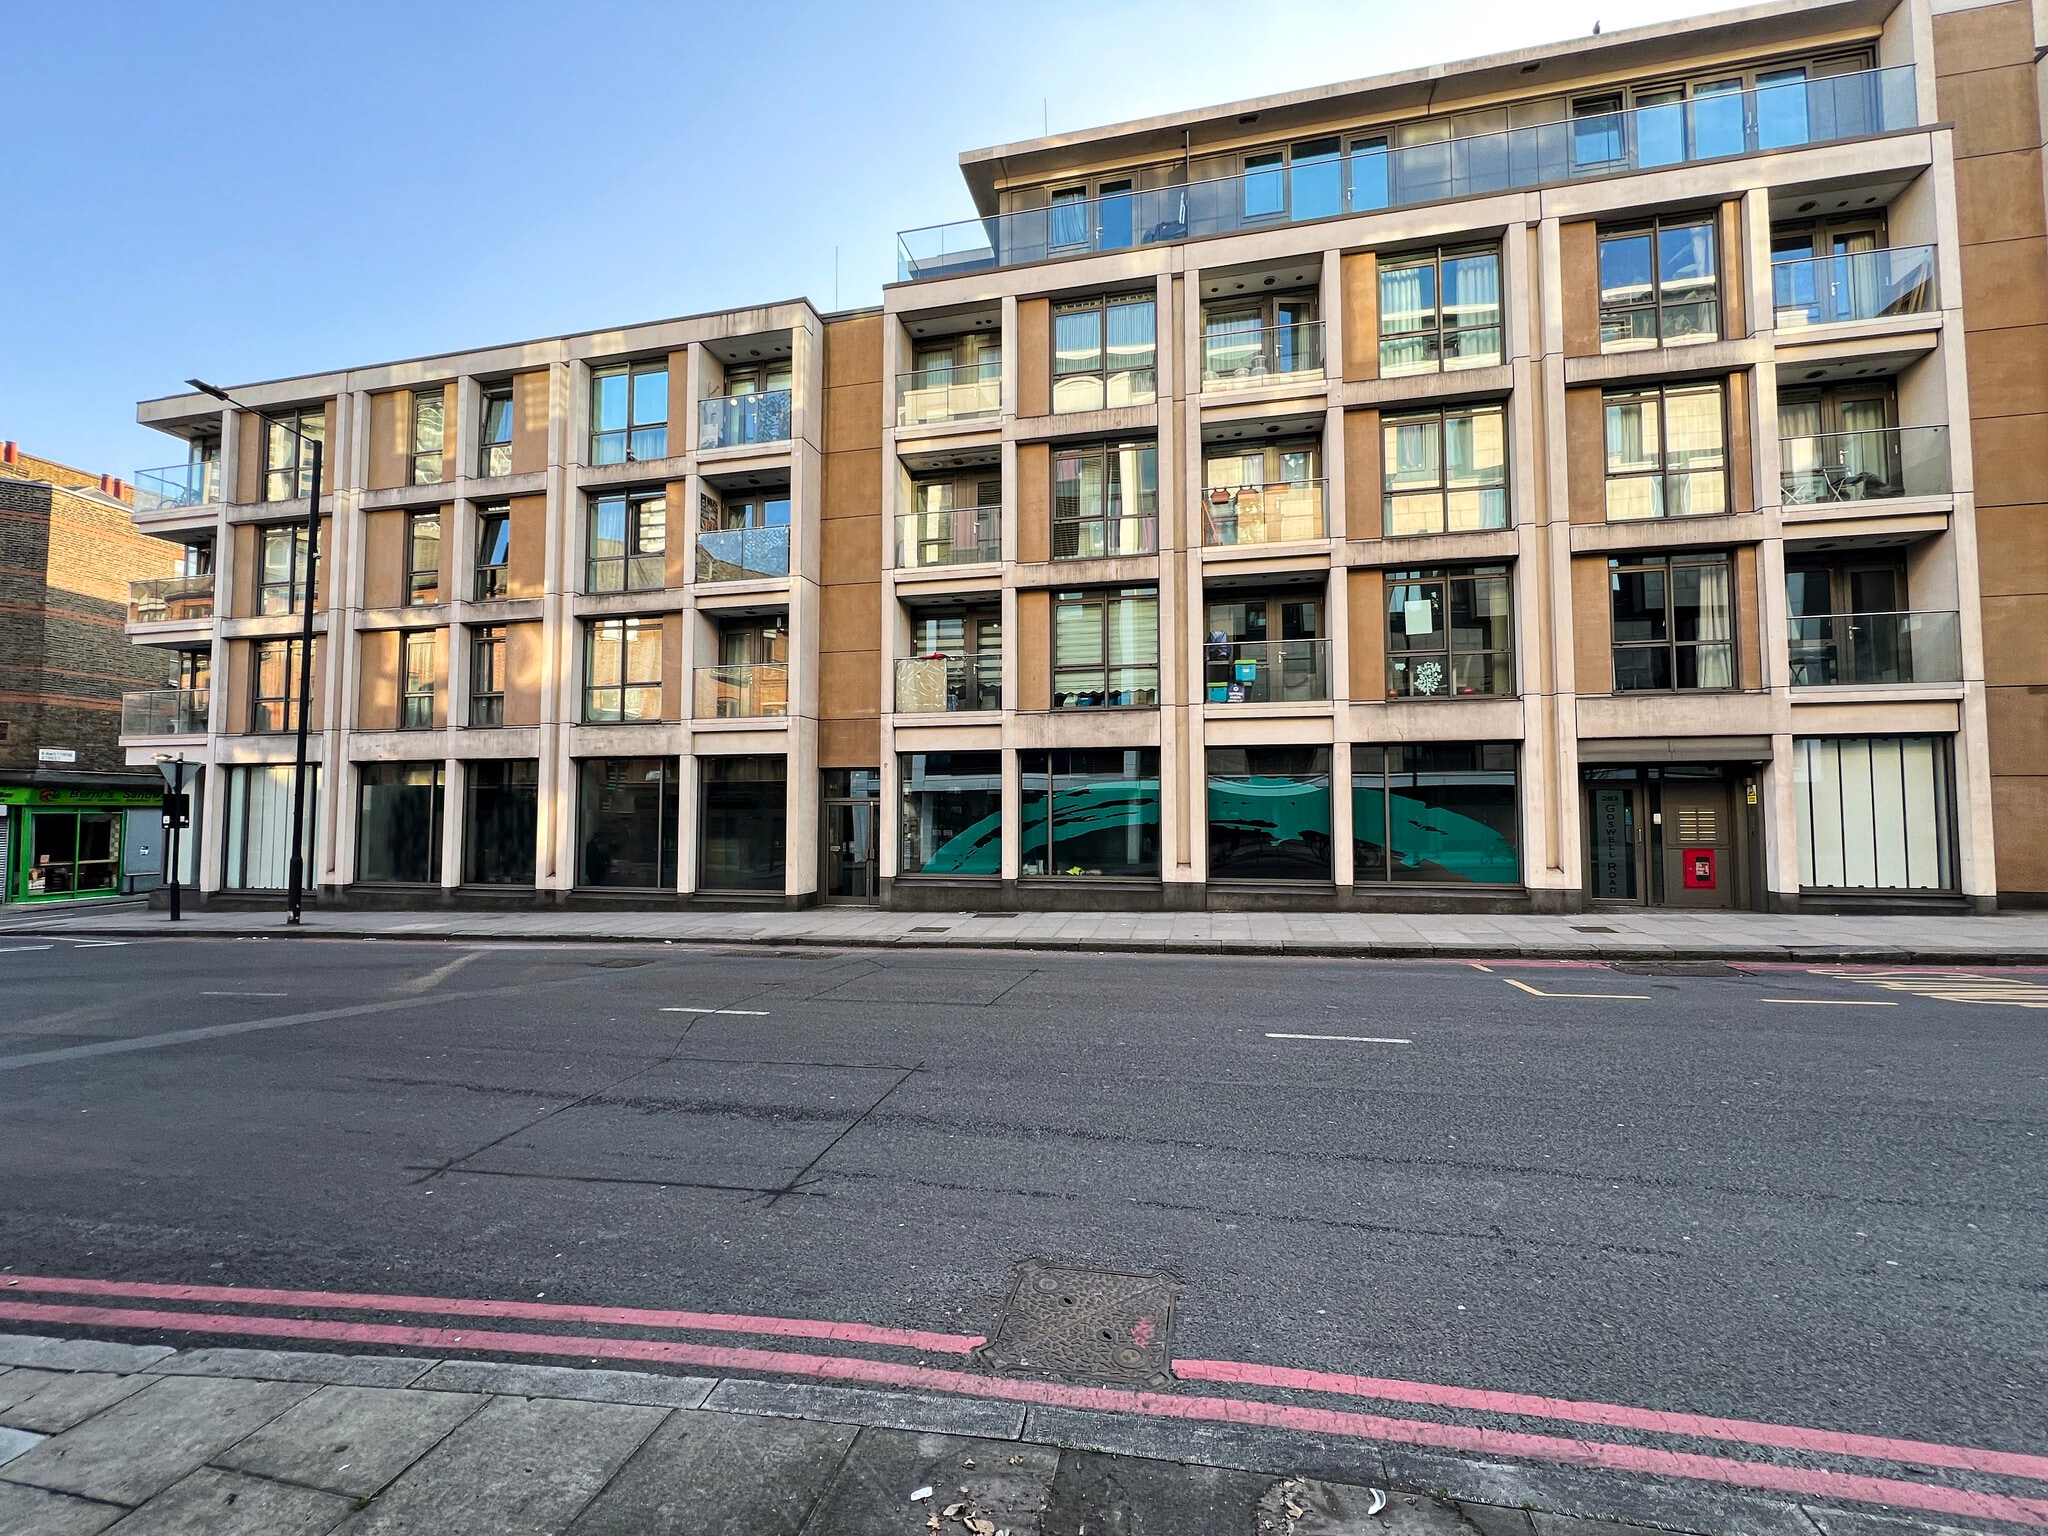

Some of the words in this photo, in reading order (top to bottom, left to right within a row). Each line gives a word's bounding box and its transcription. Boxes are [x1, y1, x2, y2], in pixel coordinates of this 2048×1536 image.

[122, 790, 163, 799] Sandw
[1605, 804, 1616, 858] GOSWELL
[1608, 862, 1617, 894] ROAD
